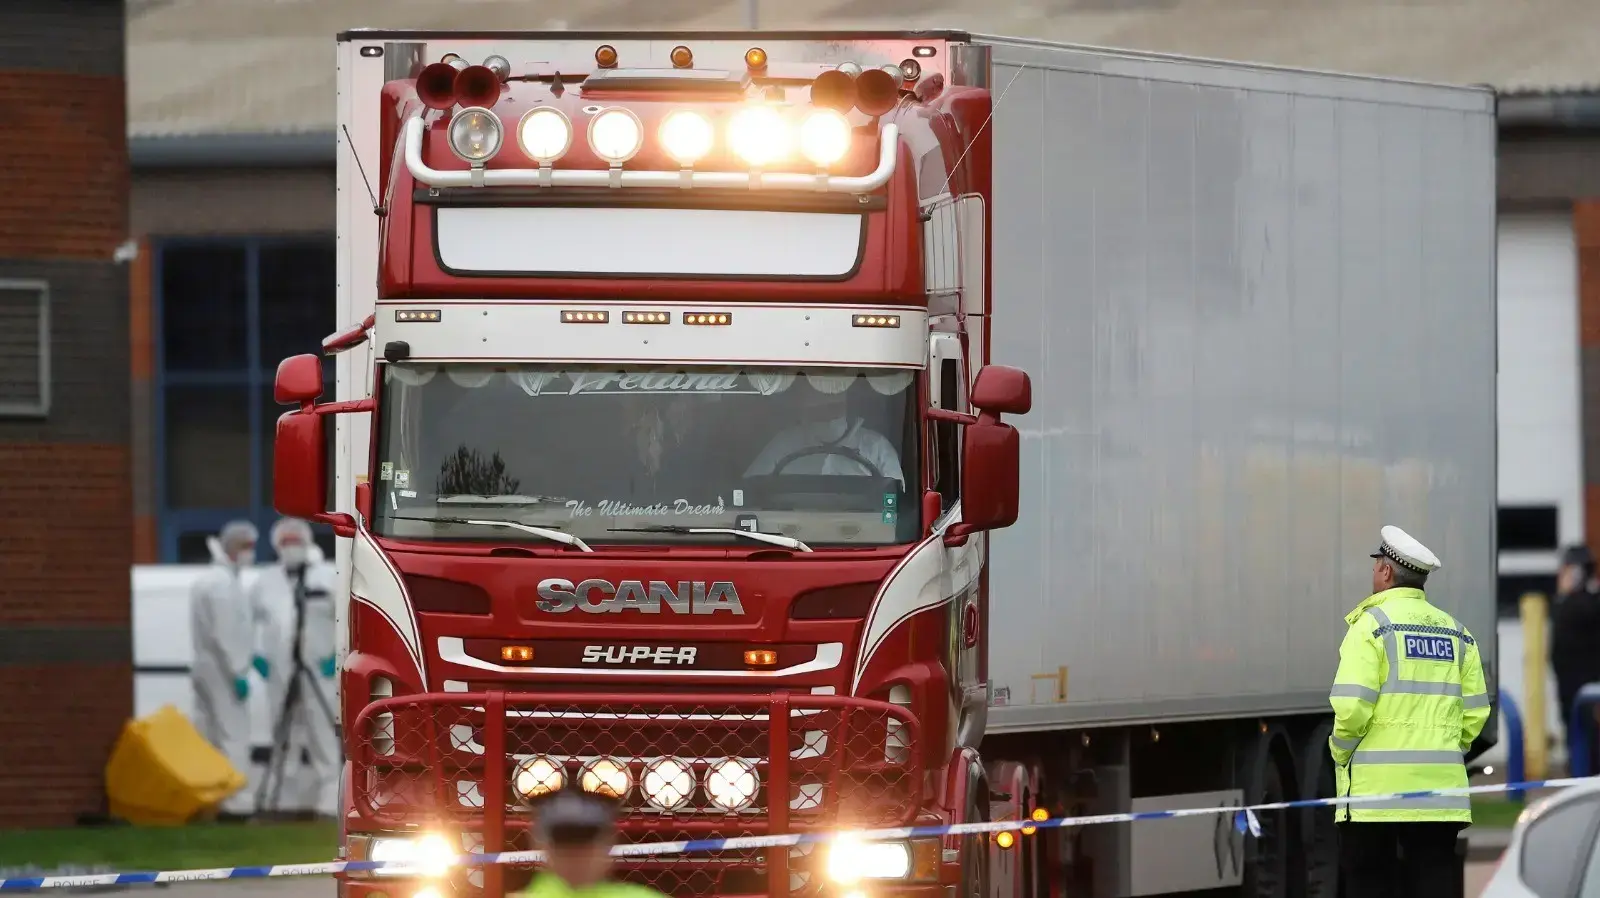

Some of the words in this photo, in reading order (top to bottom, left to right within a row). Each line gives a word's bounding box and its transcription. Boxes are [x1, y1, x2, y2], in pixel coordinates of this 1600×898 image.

[565, 500, 592, 518] The
[598, 500, 668, 516] Ultimate
[673, 498, 725, 515] Dream
[536, 578, 745, 615] SCANIA
[582, 645, 697, 664] SUPER
[1406, 638, 1452, 657] POLICE
